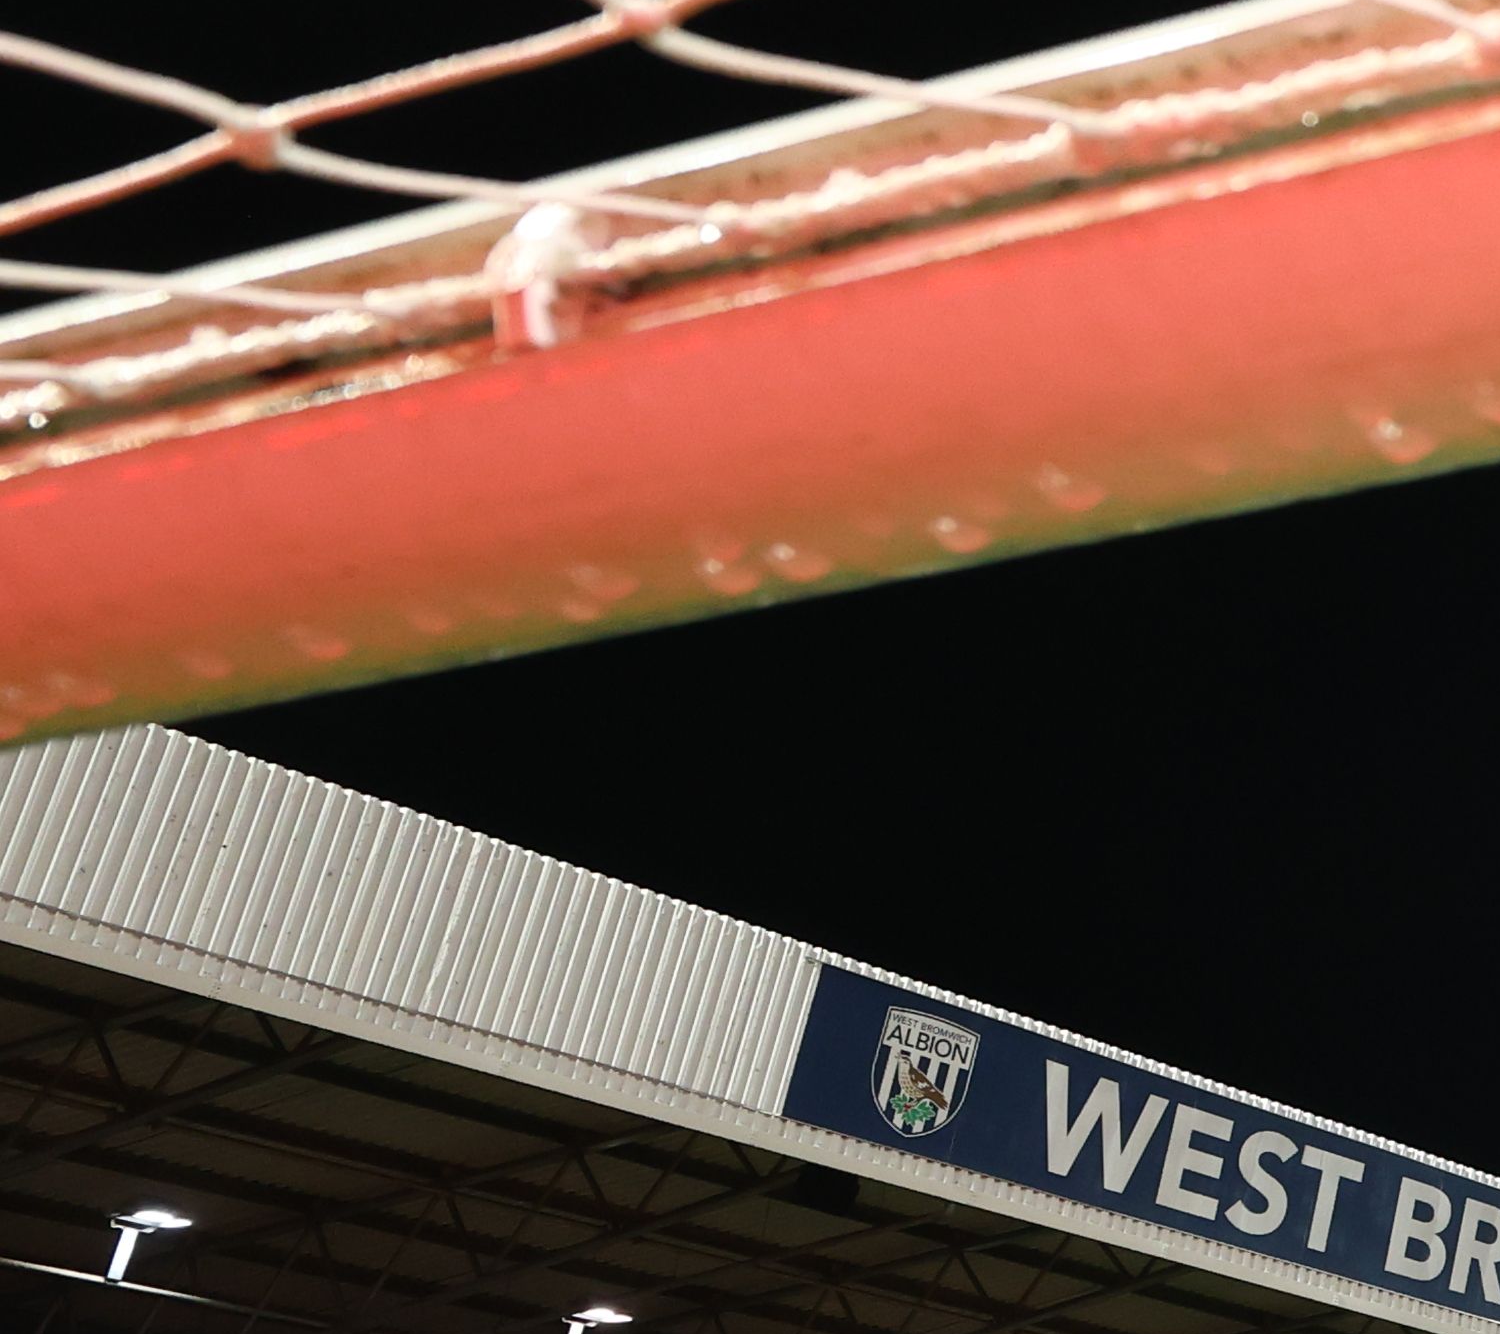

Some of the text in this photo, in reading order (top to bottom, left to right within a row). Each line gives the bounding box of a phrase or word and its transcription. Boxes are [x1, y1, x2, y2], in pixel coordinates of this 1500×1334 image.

[893, 1013, 918, 1027] WEST
[887, 1025, 970, 1064] ALBION
[1045, 1060, 1365, 1252] WEST
